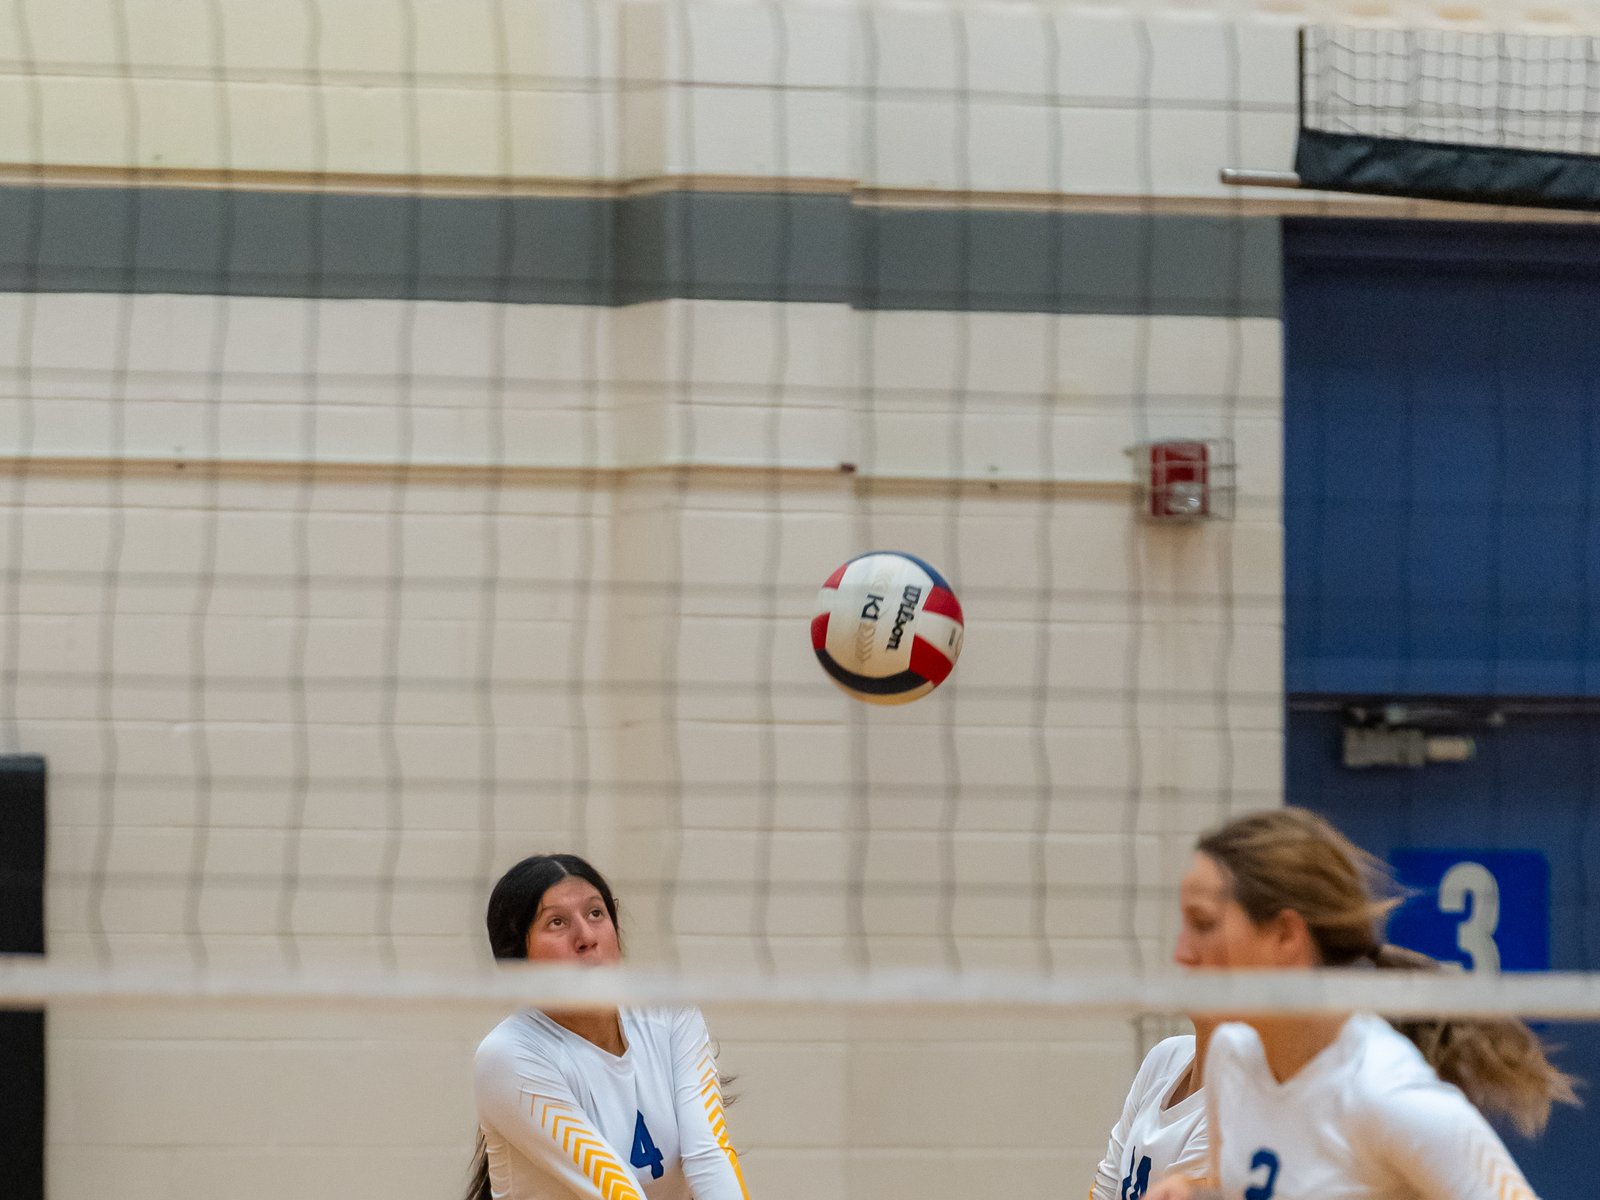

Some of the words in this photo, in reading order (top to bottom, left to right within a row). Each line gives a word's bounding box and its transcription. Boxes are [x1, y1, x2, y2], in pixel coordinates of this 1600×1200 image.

[861, 594, 885, 621] K1
[886, 584, 922, 653] Wilson
[1438, 861, 1500, 977] 3
[630, 1109, 664, 1180] 4
